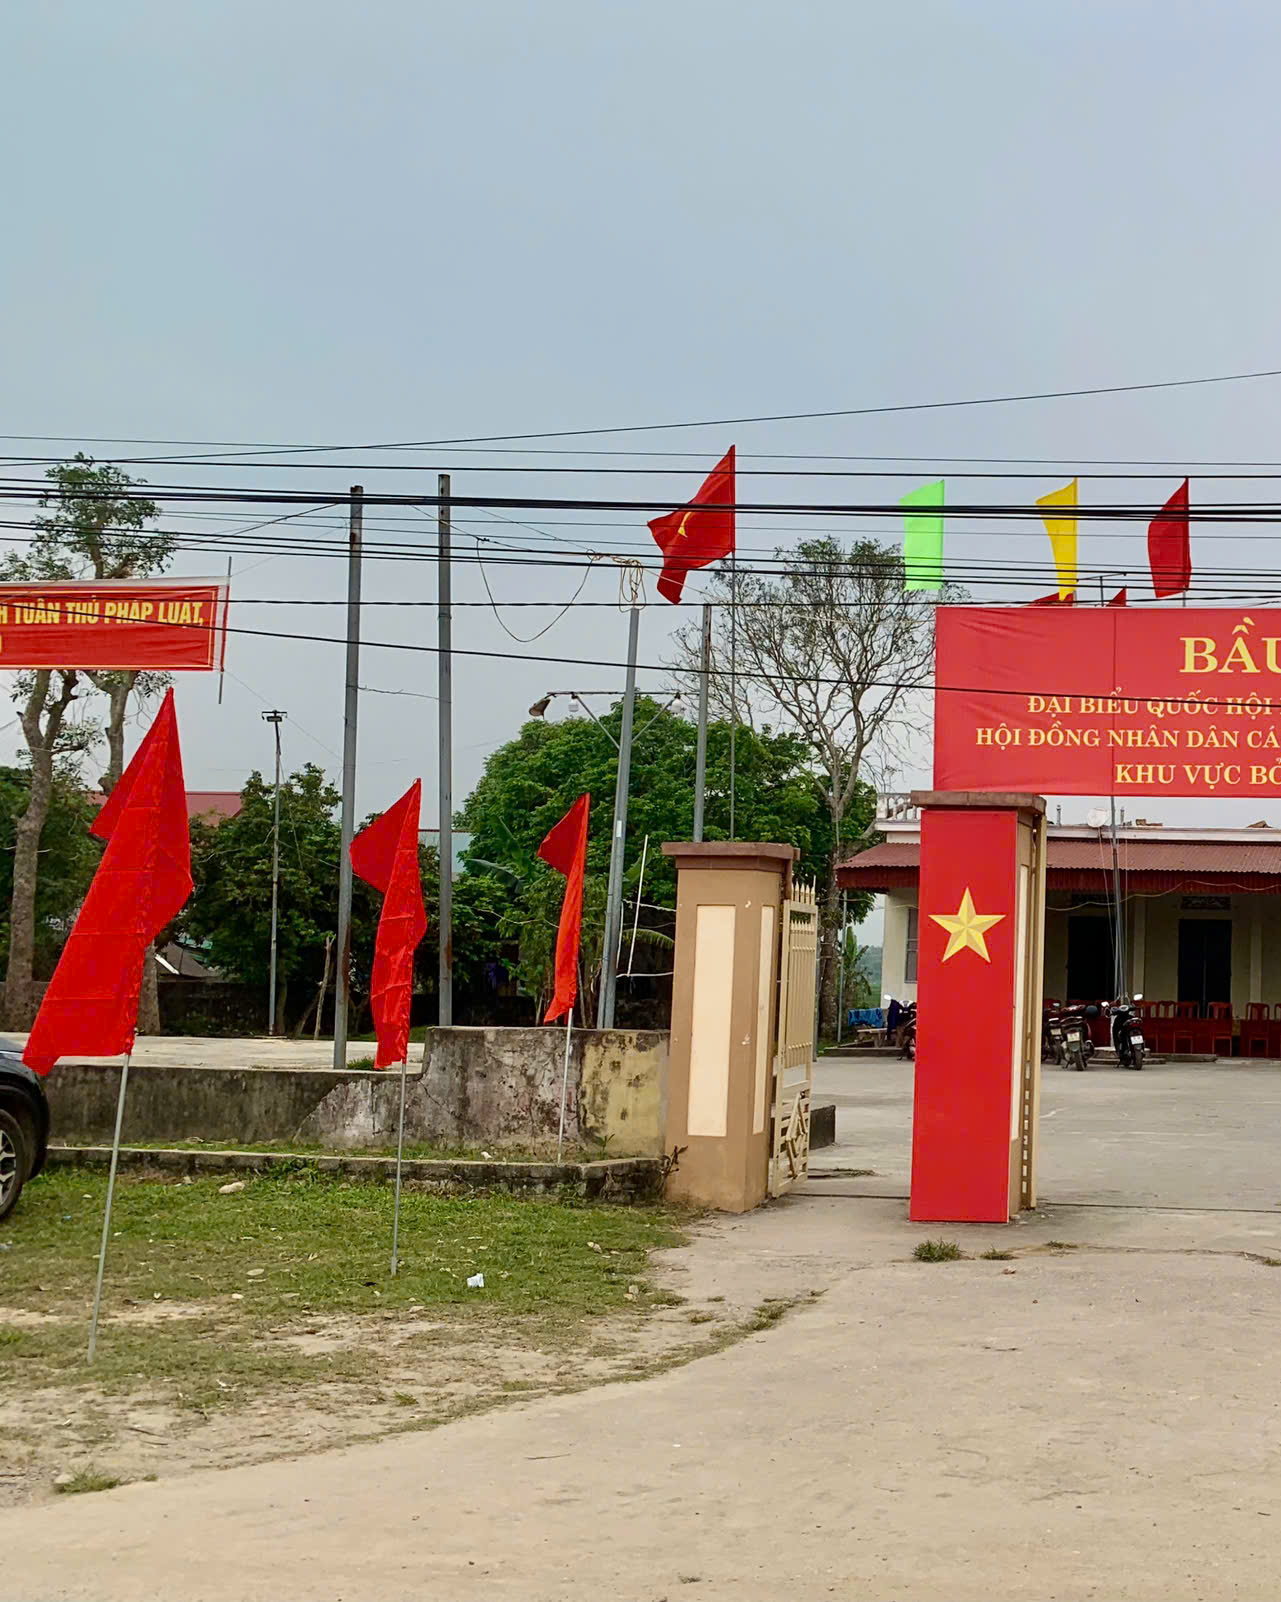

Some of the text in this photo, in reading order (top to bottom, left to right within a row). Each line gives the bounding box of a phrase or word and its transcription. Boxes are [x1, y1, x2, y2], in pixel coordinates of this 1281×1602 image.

[13, 598, 60, 624] TUÂN
[65, 595, 99, 624] THỦ
[104, 600, 153, 624] PHÁP
[1027, 695, 1072, 718] ĐẠI
[1080, 687, 1139, 714] BIỂU
[1147, 690, 1218, 718] QUỐC
[1226, 692, 1272, 720] HỘI
[976, 723, 1021, 750] HỘI
[1028, 721, 1100, 747] ĐỒNG
[1107, 725, 1178, 748] NHÂN
[1186, 725, 1240, 748] DÂN
[1115, 764, 1176, 784] KHU
[1183, 763, 1241, 789] VỰC
